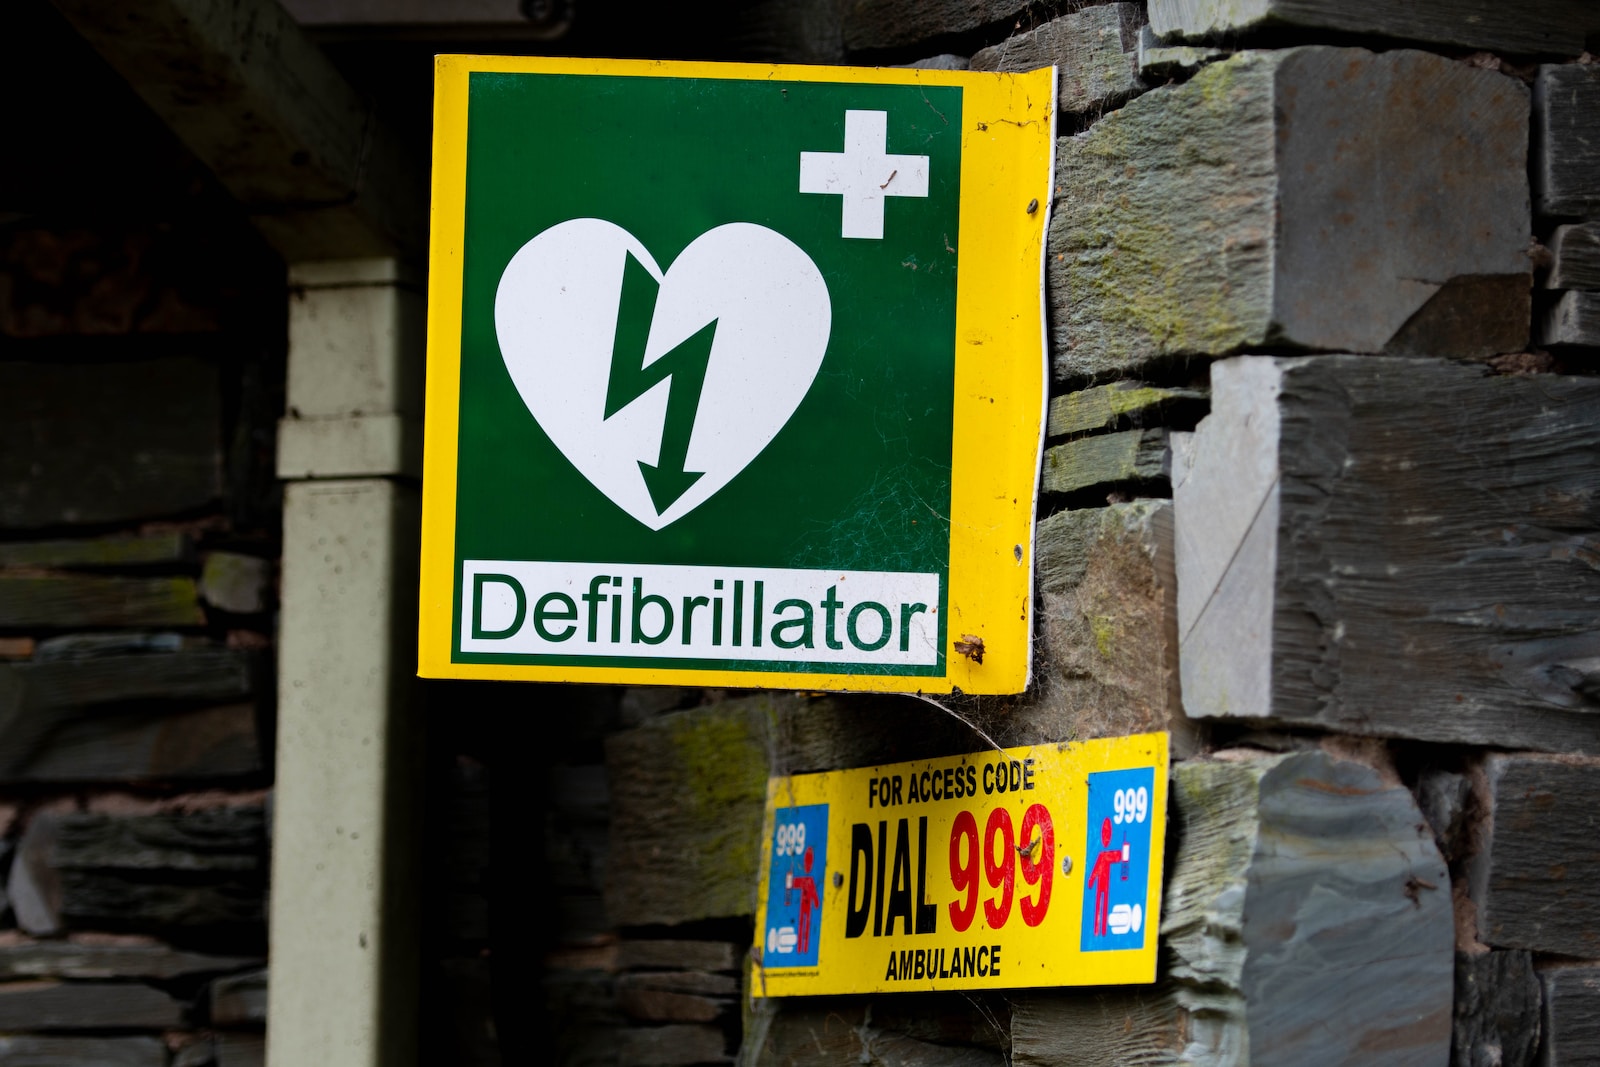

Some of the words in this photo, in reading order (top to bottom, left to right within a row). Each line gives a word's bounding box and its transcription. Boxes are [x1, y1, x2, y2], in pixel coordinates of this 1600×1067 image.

[471, 572, 928, 652] Defibrillator
[868, 773, 904, 809] FOR
[907, 767, 977, 804] ACCESS
[982, 758, 1036, 796] CODE
[1113, 786, 1149, 825] 999
[775, 822, 807, 857] 999
[844, 815, 938, 939] DIAL
[948, 803, 1056, 933] 999
[884, 945, 1002, 982] AMBULANCE
